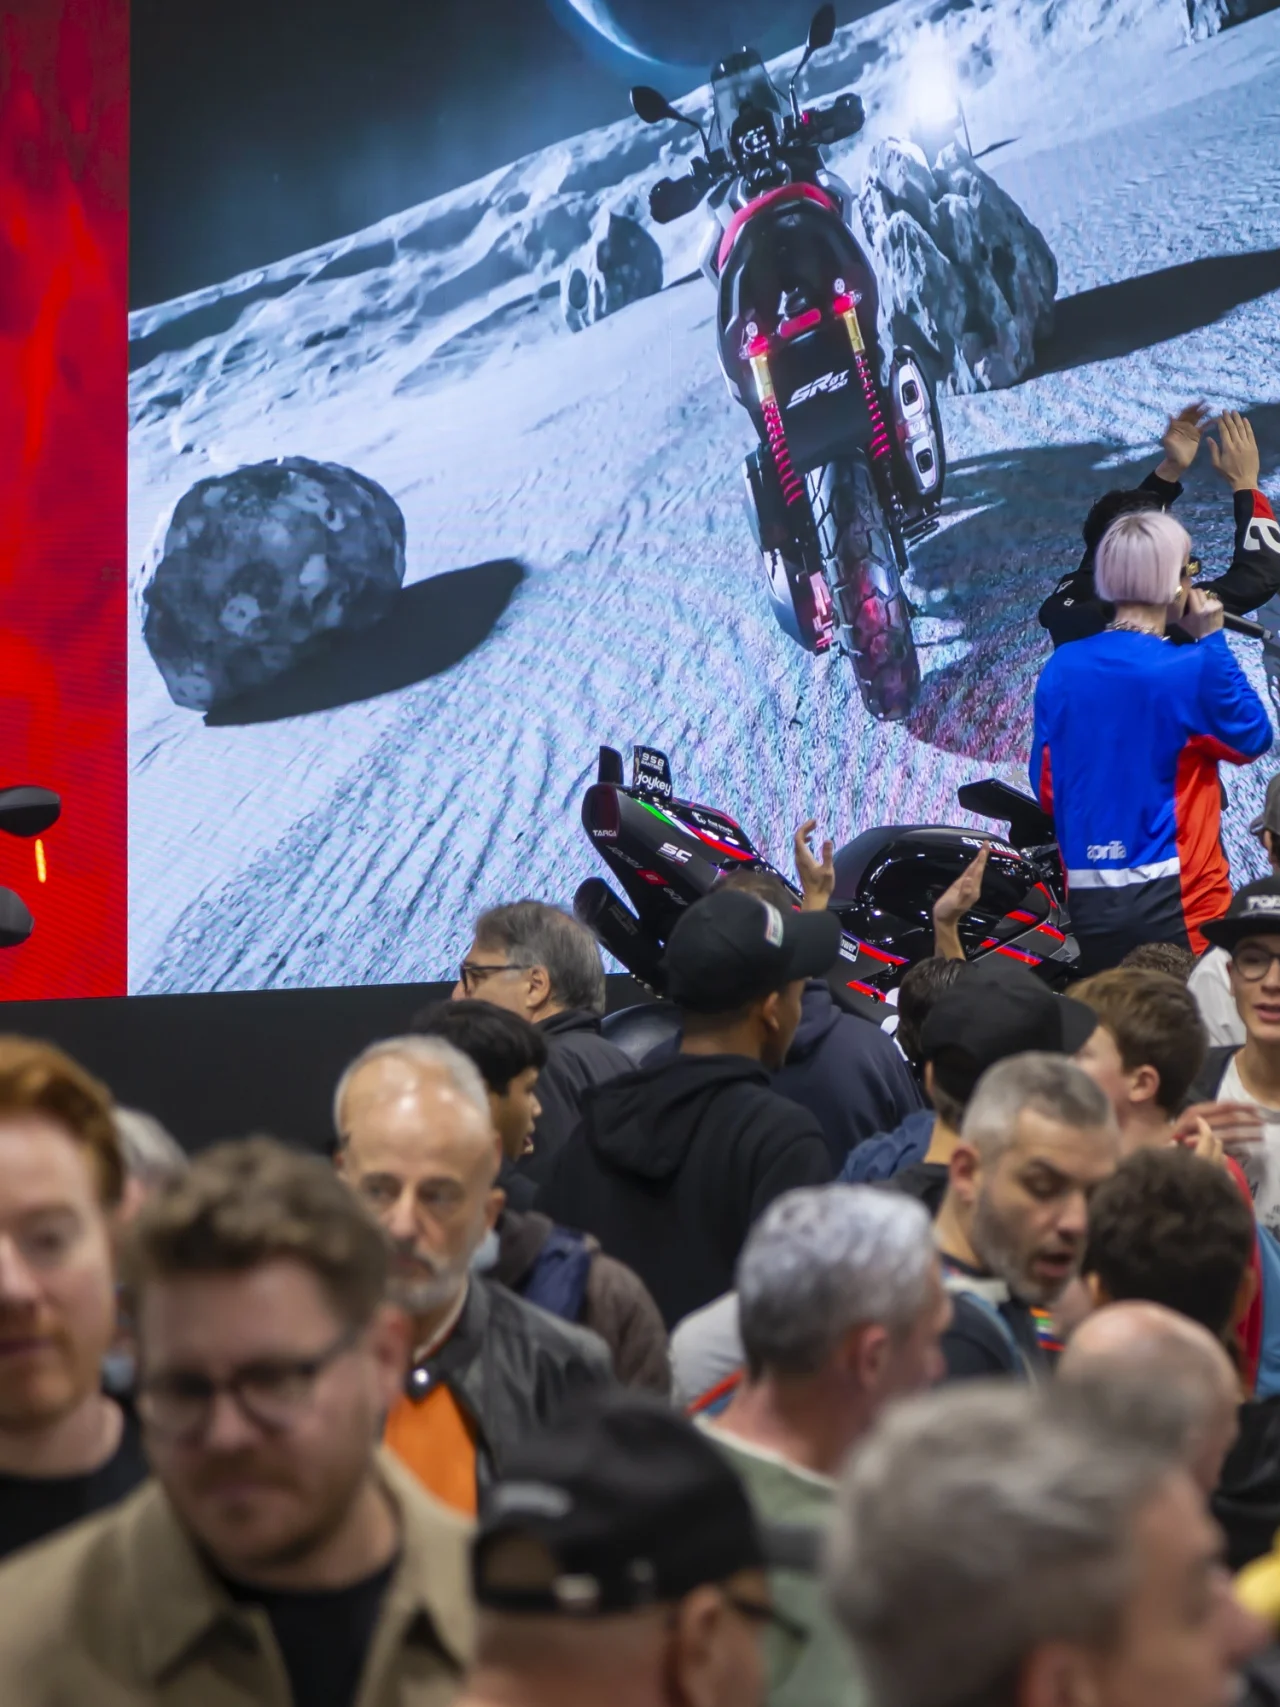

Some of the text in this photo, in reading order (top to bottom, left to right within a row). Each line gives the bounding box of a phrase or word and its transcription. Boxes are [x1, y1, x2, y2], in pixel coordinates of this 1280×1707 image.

[636, 771, 671, 796] joykey
[660, 842, 693, 863] SC
[1086, 840, 1127, 864] aprilia
